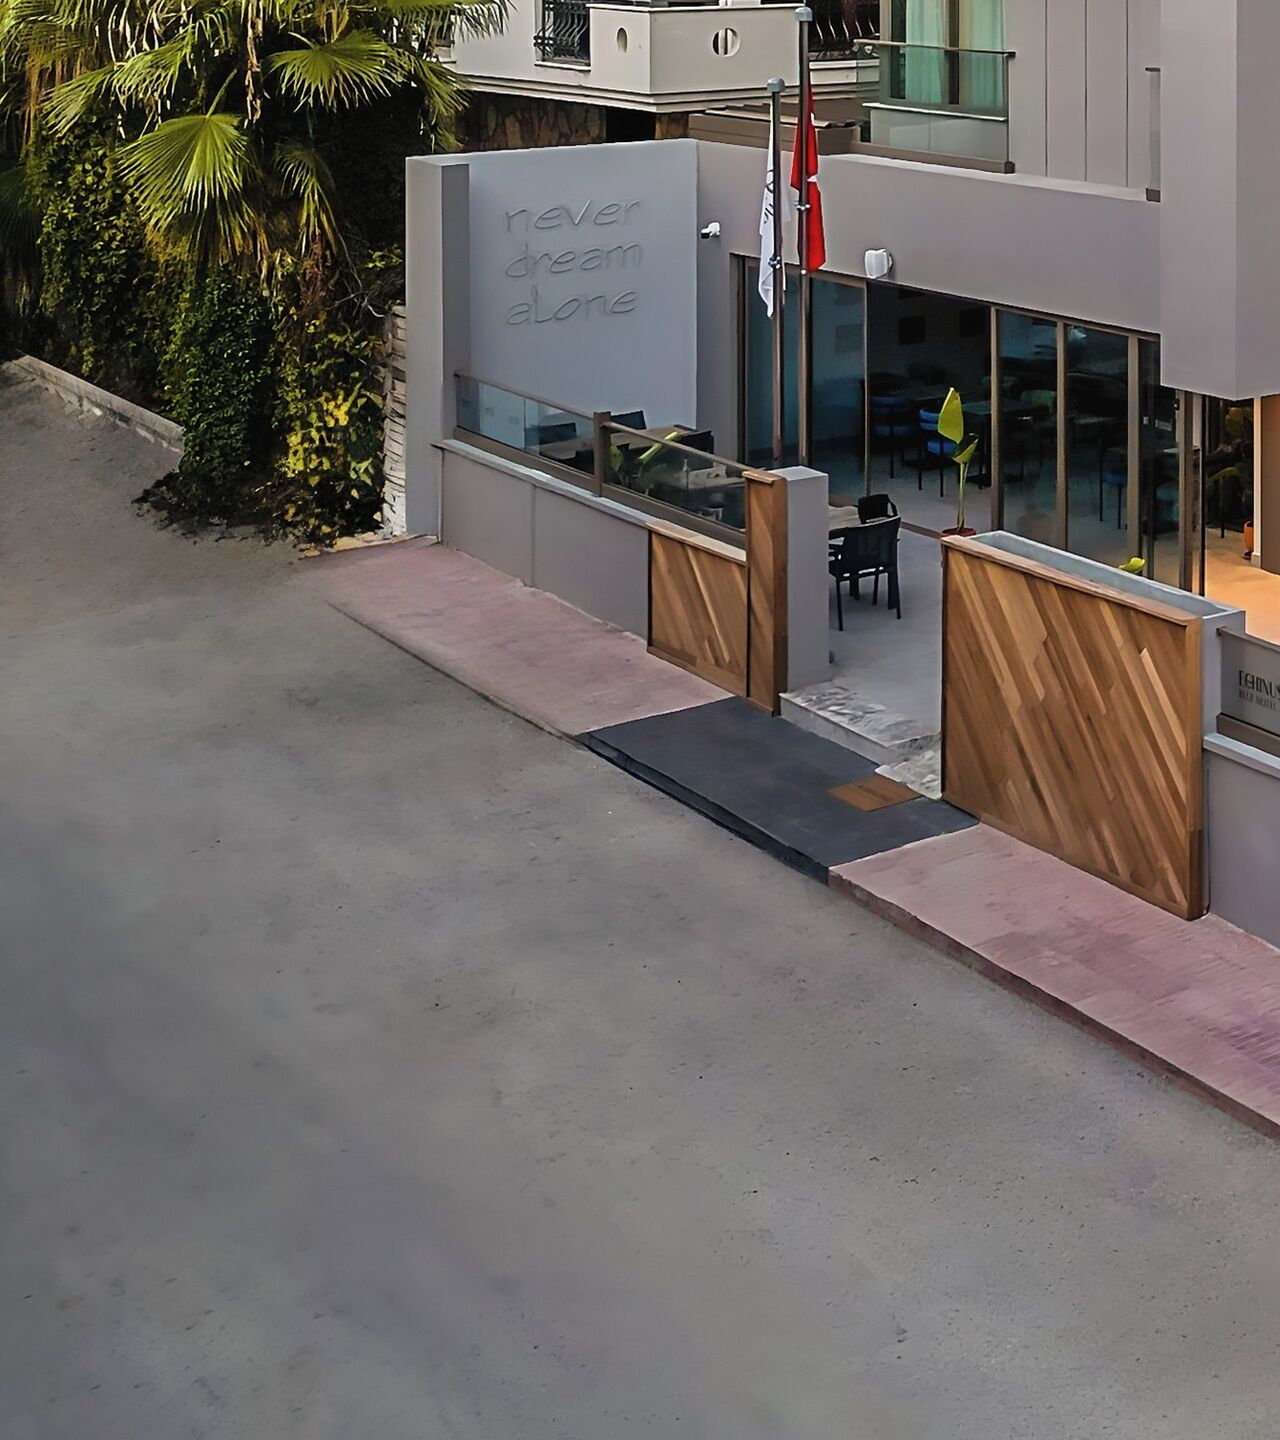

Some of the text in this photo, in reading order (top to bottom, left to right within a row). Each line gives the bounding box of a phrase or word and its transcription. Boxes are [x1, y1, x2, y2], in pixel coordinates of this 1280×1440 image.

[505, 200, 640, 232] never
[505, 243, 641, 278] dream
[506, 284, 637, 325] alone
